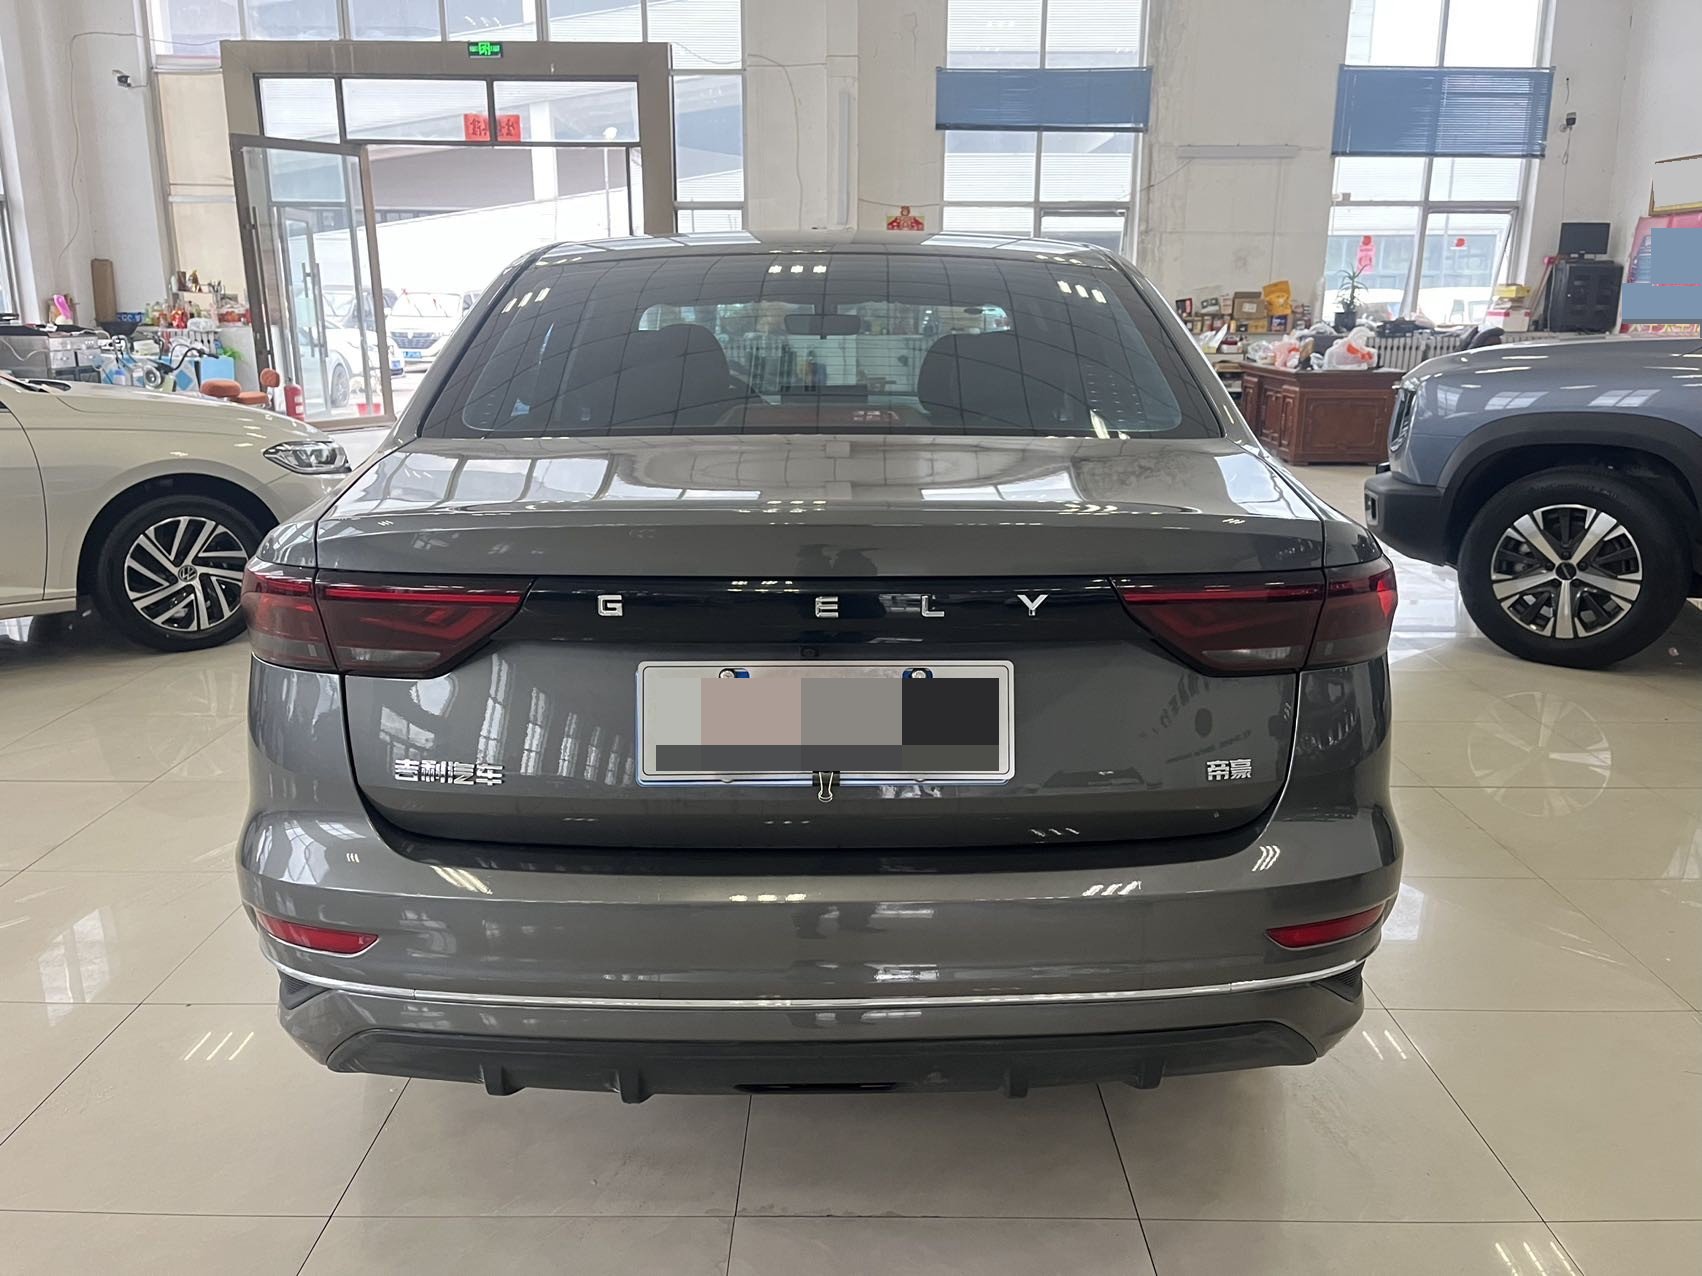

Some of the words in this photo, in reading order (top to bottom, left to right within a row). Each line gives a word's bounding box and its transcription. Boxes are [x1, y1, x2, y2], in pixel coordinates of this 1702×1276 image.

[394, 759, 503, 786] 吉利汽车
[1206, 758, 1252, 781] 帝豪
